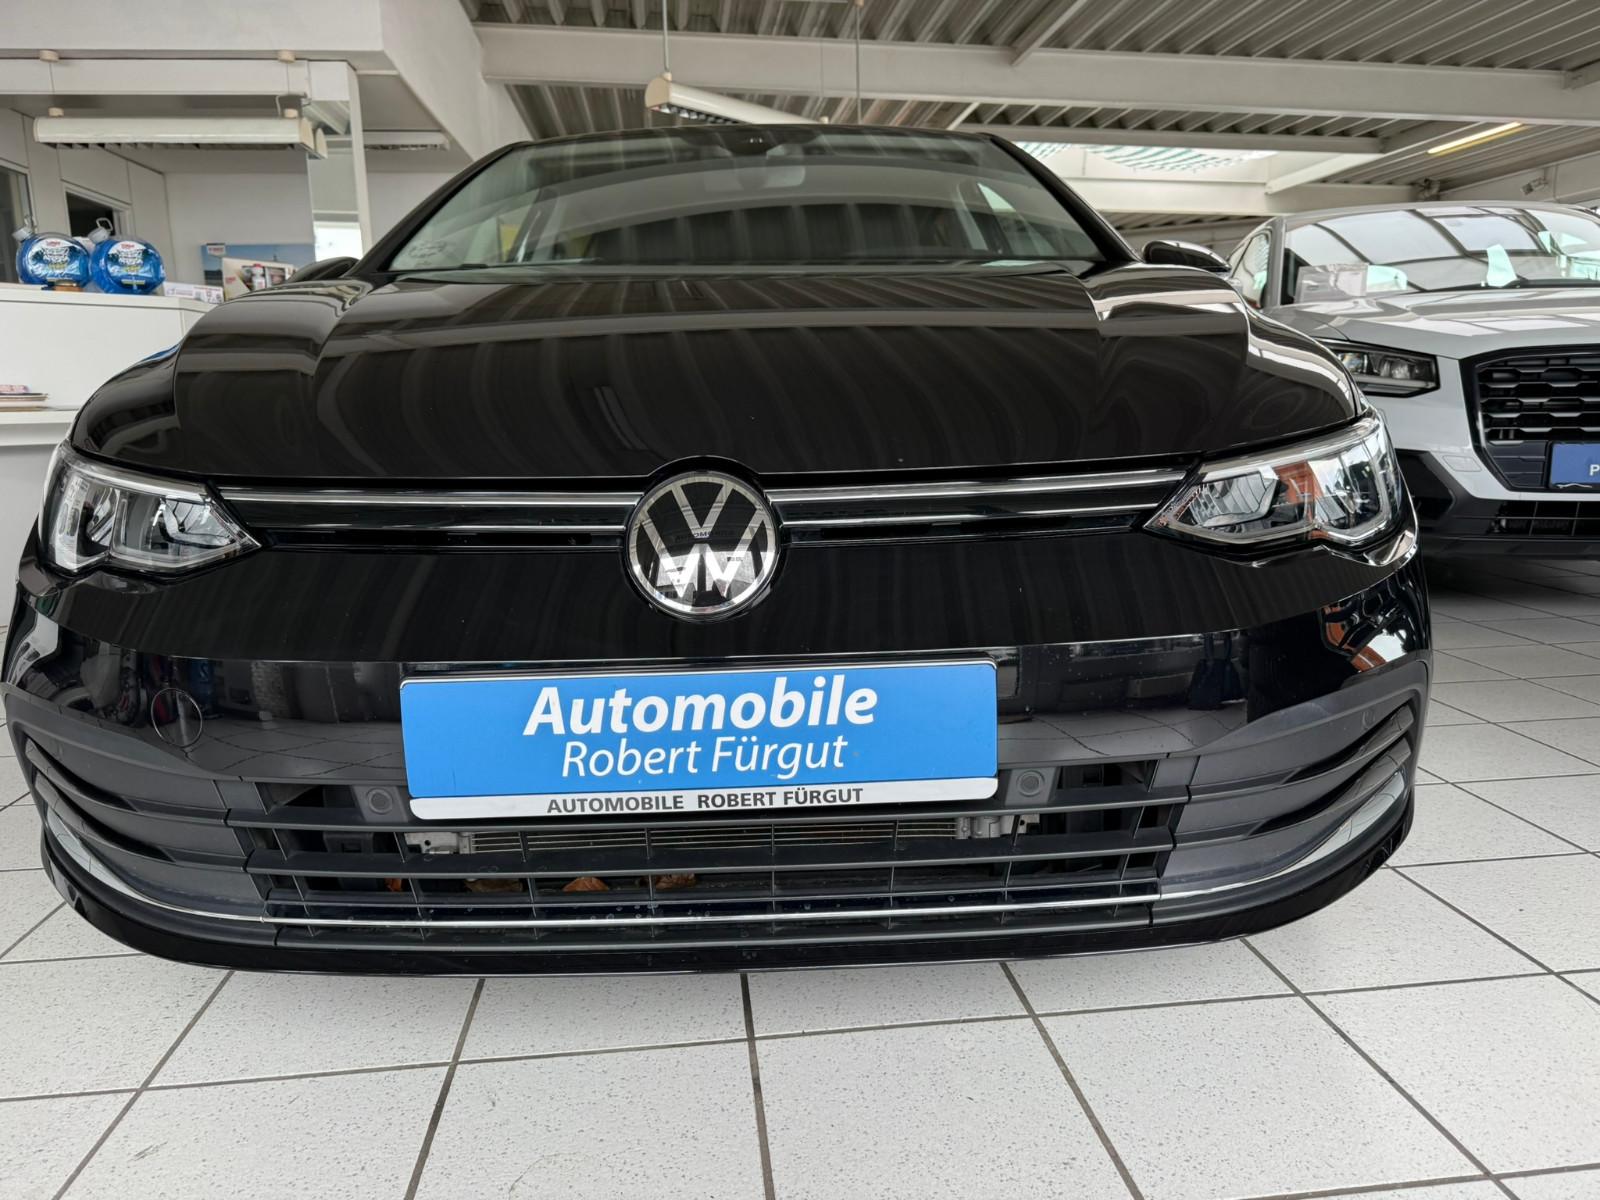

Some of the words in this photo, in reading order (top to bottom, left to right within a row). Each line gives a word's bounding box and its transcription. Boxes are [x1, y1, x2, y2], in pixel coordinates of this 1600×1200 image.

[523, 676, 877, 735] Automobile
[563, 737, 701, 776] Robert
[712, 735, 848, 779] Fürgut
[548, 796, 684, 813] AUTOMOBILE
[698, 792, 777, 809] ROBERT
[784, 787, 863, 805] FÜRGUT
